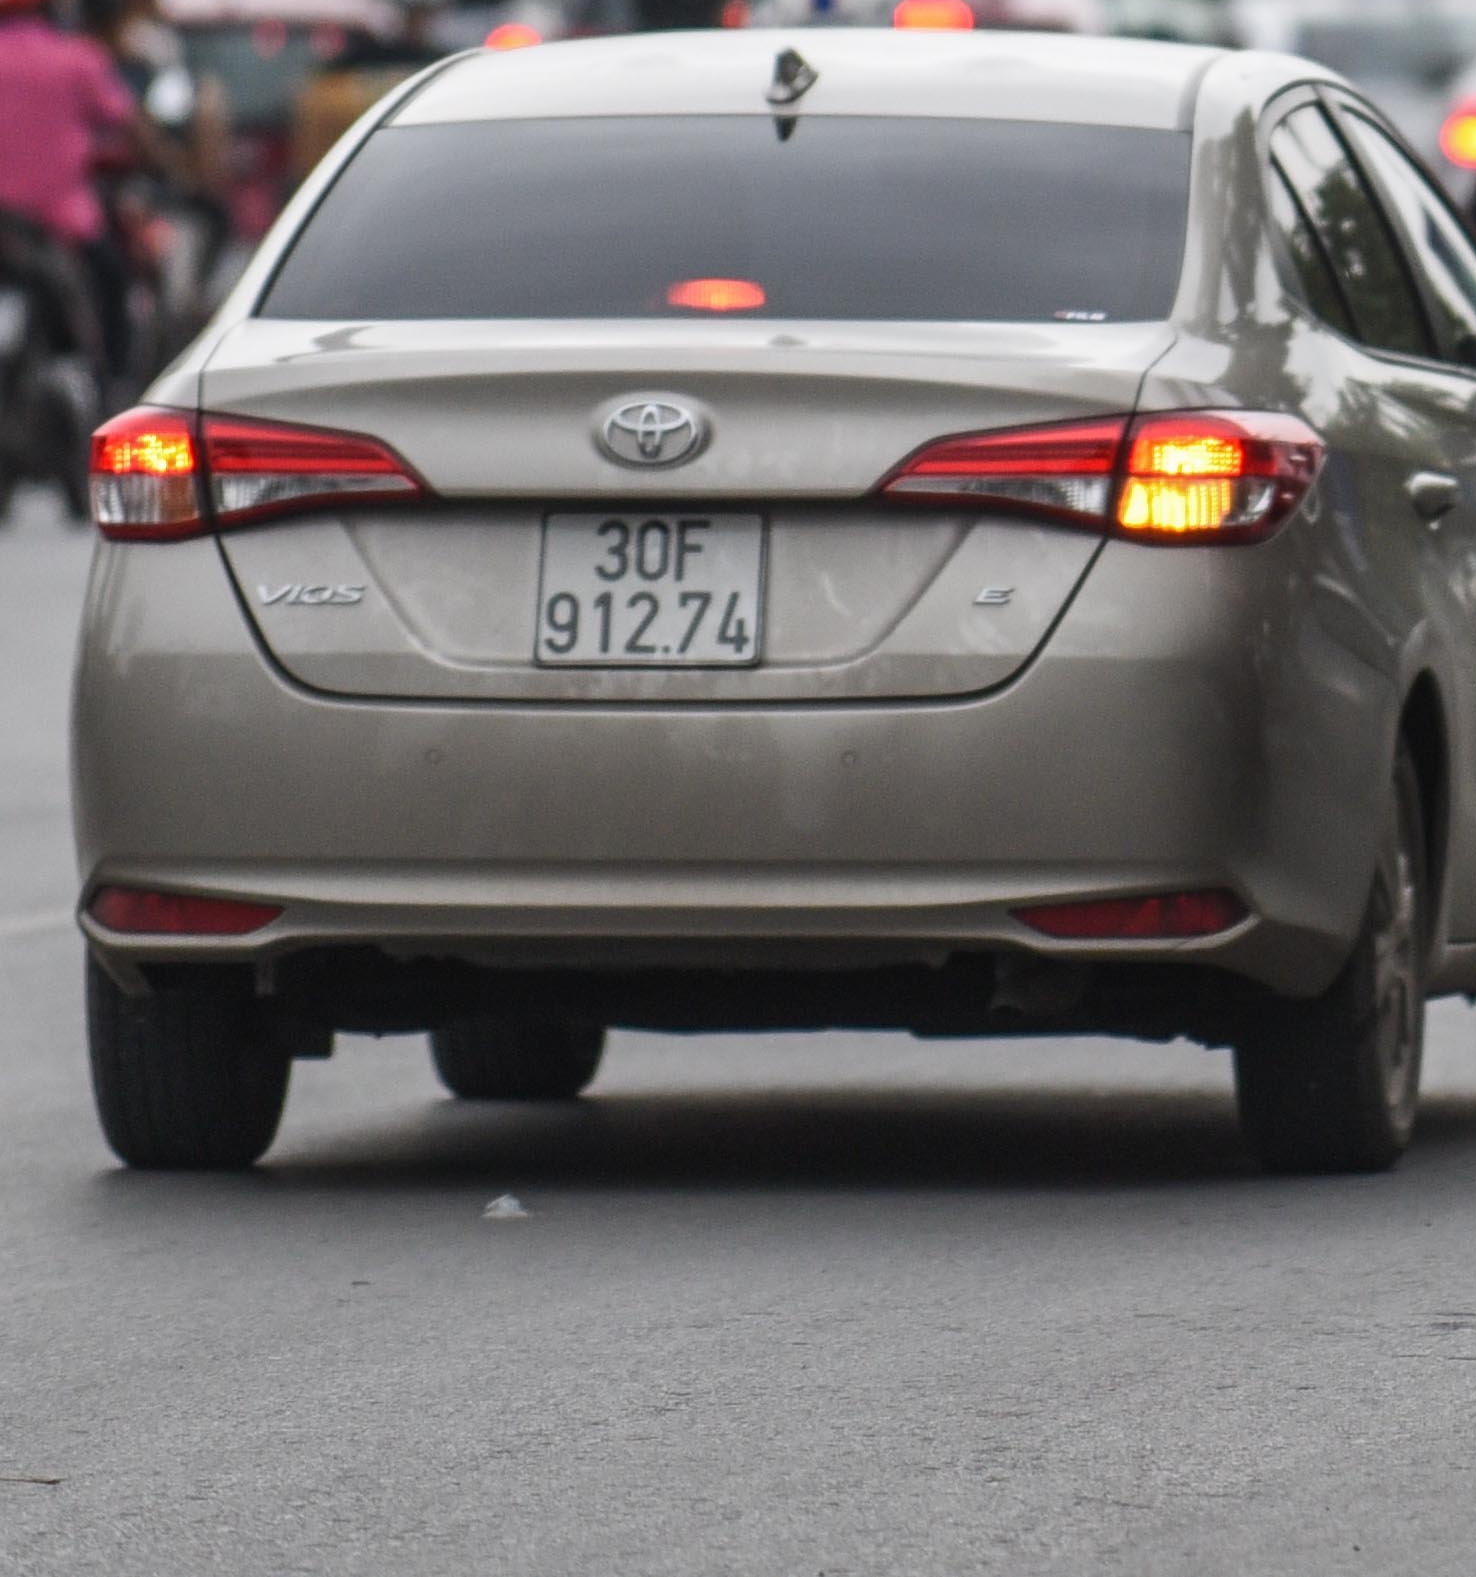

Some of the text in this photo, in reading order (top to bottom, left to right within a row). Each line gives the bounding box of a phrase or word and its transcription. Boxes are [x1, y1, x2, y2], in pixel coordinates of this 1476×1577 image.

[595, 520, 711, 582] 30F
[257, 584, 367, 606] VIOS
[544, 591, 750, 654] 912.74
